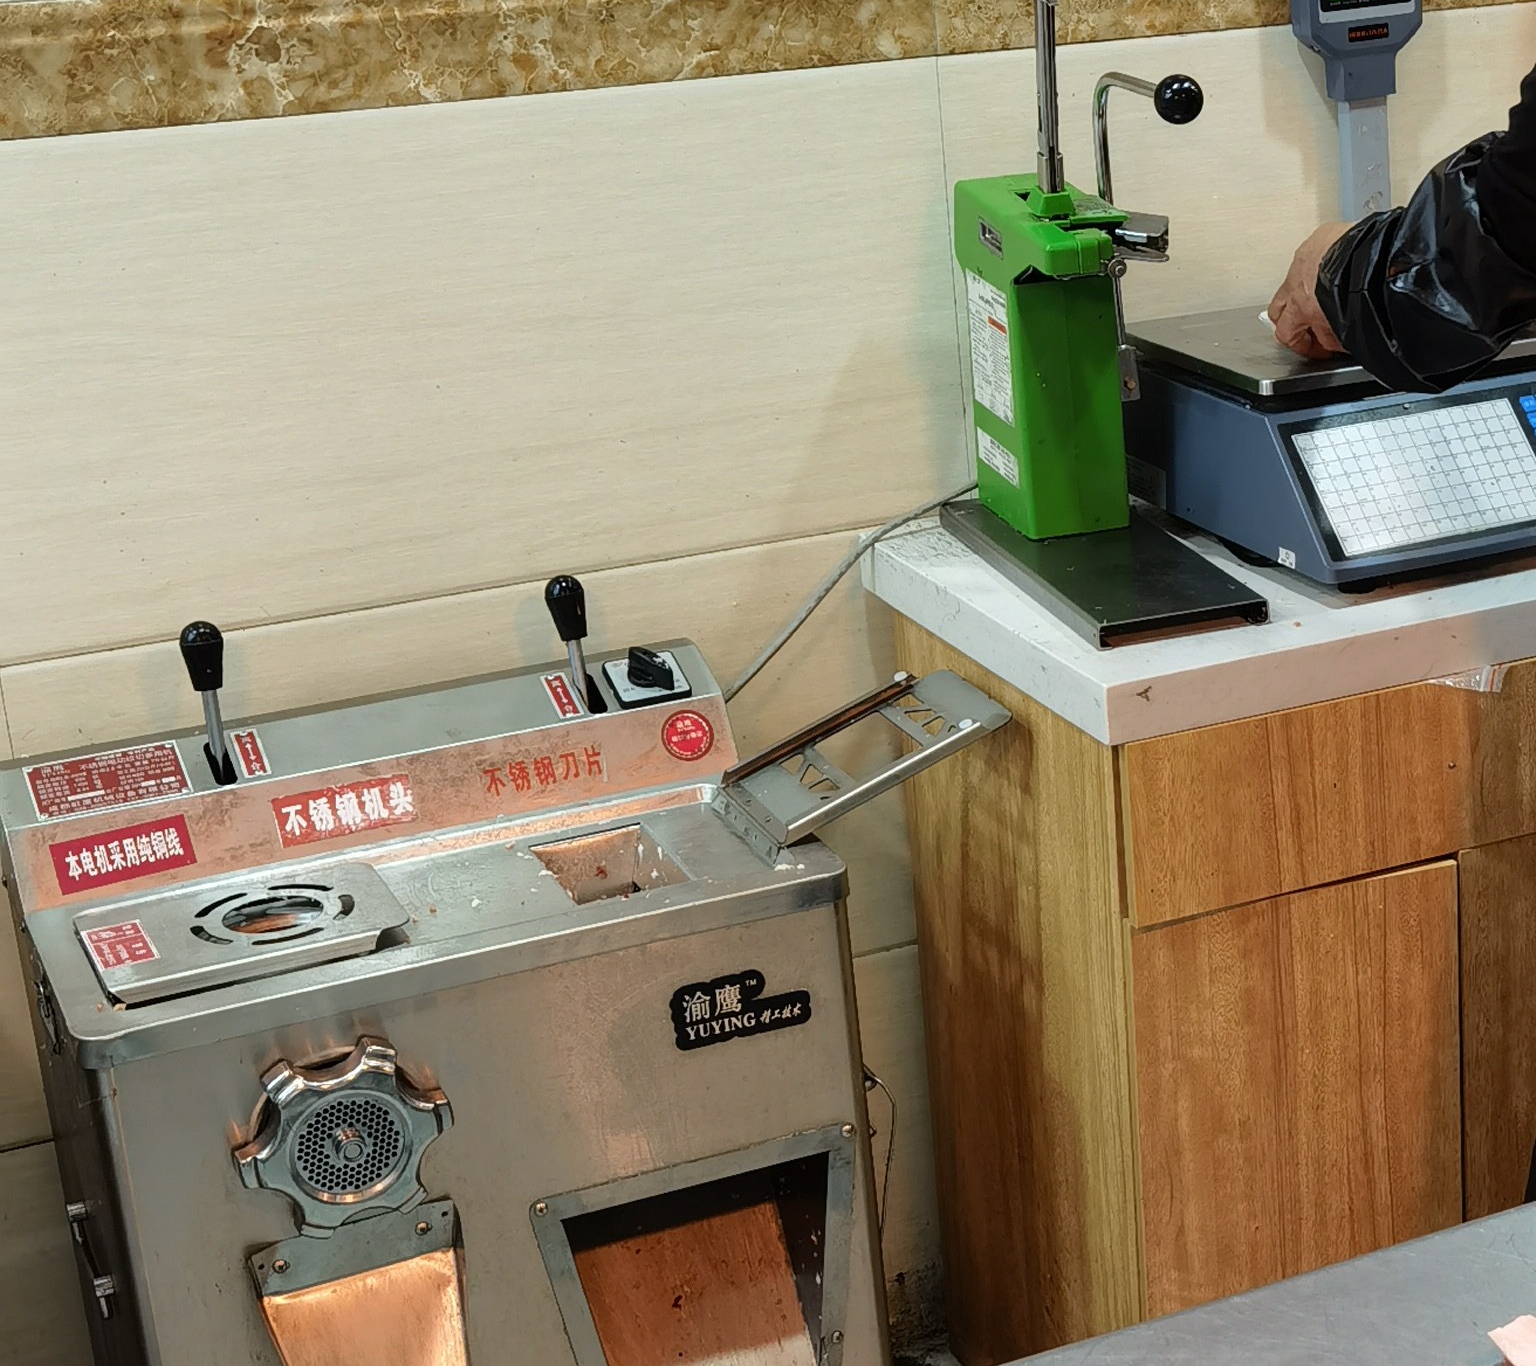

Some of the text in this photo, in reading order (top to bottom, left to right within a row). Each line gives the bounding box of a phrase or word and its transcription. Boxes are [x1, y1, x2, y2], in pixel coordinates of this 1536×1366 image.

[483, 745, 603, 797] 不锈钢刀片
[281, 781, 414, 836] 不锈钢机头
[65, 827, 184, 881] 本电机采用纯铜线
[682, 984, 742, 1023] 渝鹰
[685, 1012, 756, 1041] YUYING
